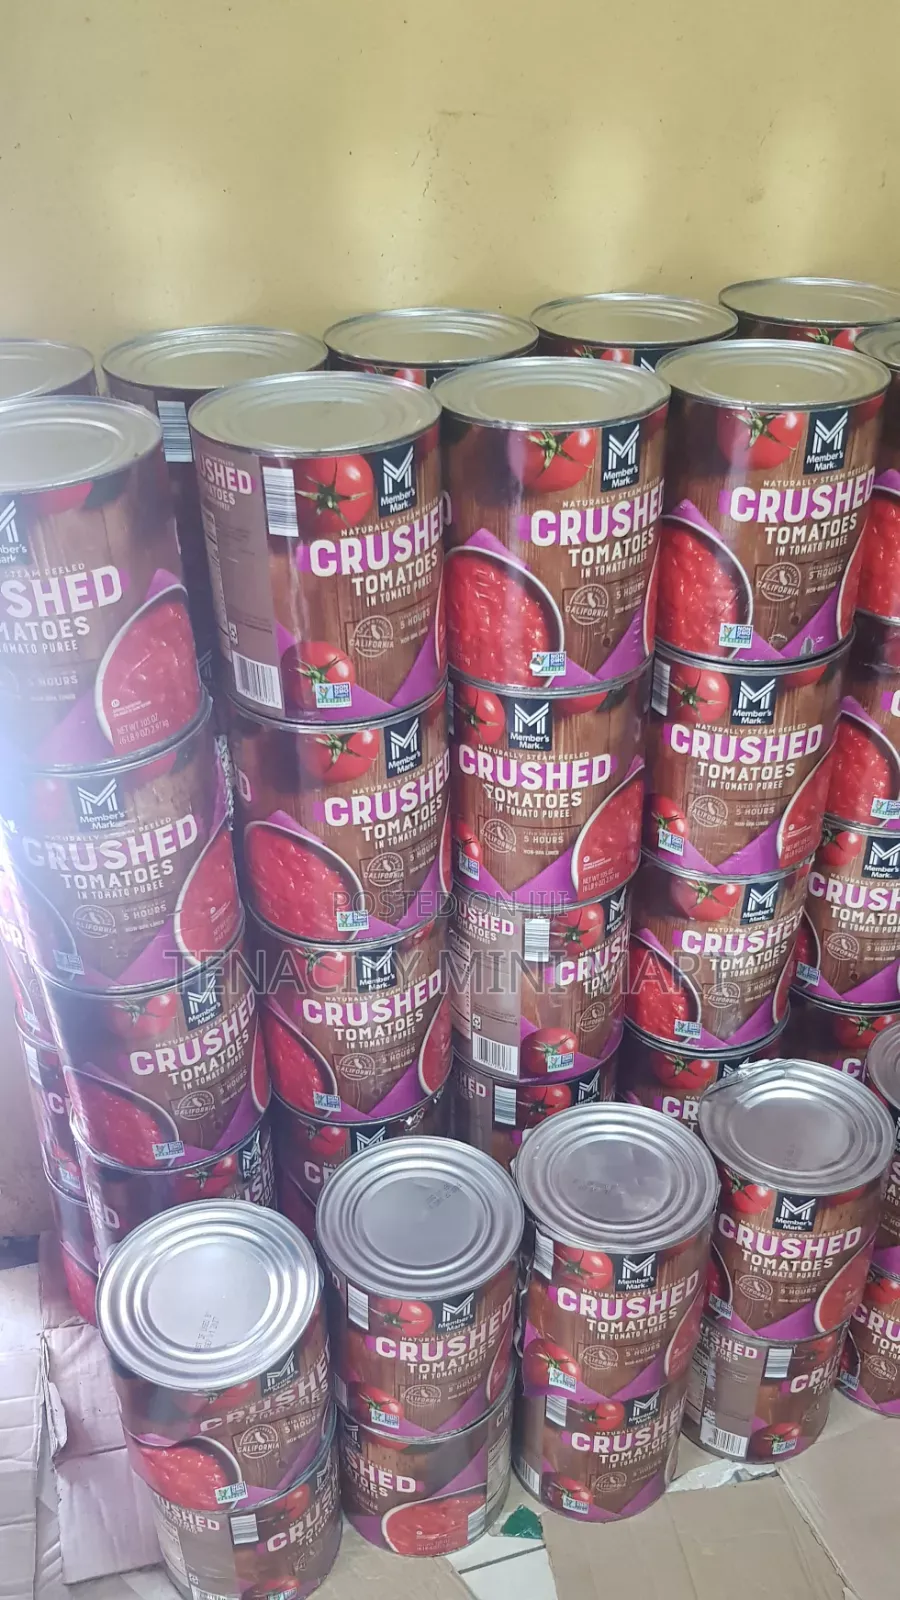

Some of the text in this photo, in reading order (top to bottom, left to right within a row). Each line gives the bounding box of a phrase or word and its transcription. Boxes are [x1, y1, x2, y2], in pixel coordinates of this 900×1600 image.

[806, 450, 844, 464] Member's
[603, 465, 638, 482] Member's
[763, 472, 845, 488] NATURALLY STEAM
[381, 487, 416, 506] Member's
[562, 486, 641, 508] NATURALLY STEAM
[730, 466, 876, 523] CRUSHED
[531, 477, 664, 547] CRUSHED
[340, 518, 396, 537] NATURALLY
[765, 513, 857, 545] TOMATOES
[310, 500, 443, 577] CRUSHE
[568, 527, 654, 568] TOMATOES
[775, 536, 848, 557] IN TOMATO PUREE
[45, 563, 86, 577] PEELED
[352, 548, 437, 596] TOMATOES
[580, 551, 648, 579] IN TOMATO PUREE
[366, 595, 377, 608] IN
[380, 585, 411, 604] TOMATO
[756, 580, 800, 597] CALIFORNIA
[565, 604, 609, 618] CALIFORNIA
[43, 640, 79, 653] PUREE
[349, 639, 394, 649] CALIFORNIA
[732, 708, 772, 718] Member's
[510, 732, 550, 743] Member's
[695, 722, 745, 735] NATURALLY
[747, 727, 776, 735] STEAM
[478, 744, 590, 761] NATURALLY STEAM PEELED
[670, 723, 823, 765] CRUSHED
[388, 750, 421, 769] Member's
[459, 744, 612, 790] CRUSHED
[698, 762, 796, 782] TOMATOES
[325, 748, 450, 827] CRUSHED
[352, 779, 402, 795] NATURALLY
[707, 780, 783, 791] IN TOMATO PUREE
[80, 811, 125, 824] Member's
[362, 794, 442, 842] TOMATOES
[506, 806, 570, 818] TOMATO PUREE
[689, 807, 728, 827] CALIFORNIA
[22, 814, 198, 872] CRUSHED
[375, 839, 384, 850] IN
[387, 830, 417, 847] TOMATO
[533, 835, 564, 844] HOURS
[61, 859, 174, 890] TOMATOES
[363, 869, 404, 880] CALIFORNIA
[864, 864, 900, 873] Member's
[77, 880, 164, 900] IN TOMATO PUREE
[133, 903, 167, 919] HOURS
[743, 907, 774, 919] Member's
[830, 905, 900, 925] TOMATO
[850, 923, 879, 933] TOMATO
[710, 942, 787, 971] TOMATOES
[823, 940, 859, 960] CALIFORNIA
[359, 973, 395, 986] Member's
[730, 966, 759, 978] TOMATO
[302, 969, 441, 1027] CRUSHED
[130, 986, 255, 1076] CRUSHED
[334, 1008, 424, 1042] TOMATOES
[346, 1026, 416, 1049] IN TOMATO PUREE
[168, 1029, 249, 1086] TOMATOES
[183, 1081, 192, 1091] IN
[195, 1067, 225, 1087] TOMATO
[740, 1219, 787, 1237] NATURALLY
[775, 1217, 812, 1227] Member's
[718, 1212, 862, 1260] CRUSHED
[741, 1249, 833, 1272] TOMATOES
[617, 1275, 655, 1286] Member's
[750, 1265, 822, 1279] IN TOMATO PUREE
[557, 1271, 700, 1321] CRUSHED
[582, 1287, 630, 1299] NATURALLY
[375, 1294, 513, 1363] CRUSHED
[438, 1313, 474, 1330] Member's
[586, 1307, 678, 1334] TOMATOES
[597, 1333, 606, 1341] IN
[407, 1334, 496, 1376] TOMATOES
[418, 1373, 428, 1381] IN
[432, 1365, 463, 1379] TOMATO
[200, 1336, 330, 1432] CRUSHE
[237, 1442, 280, 1453] CALIFORNIA
[599, 1429, 674, 1465] TOMATOES
